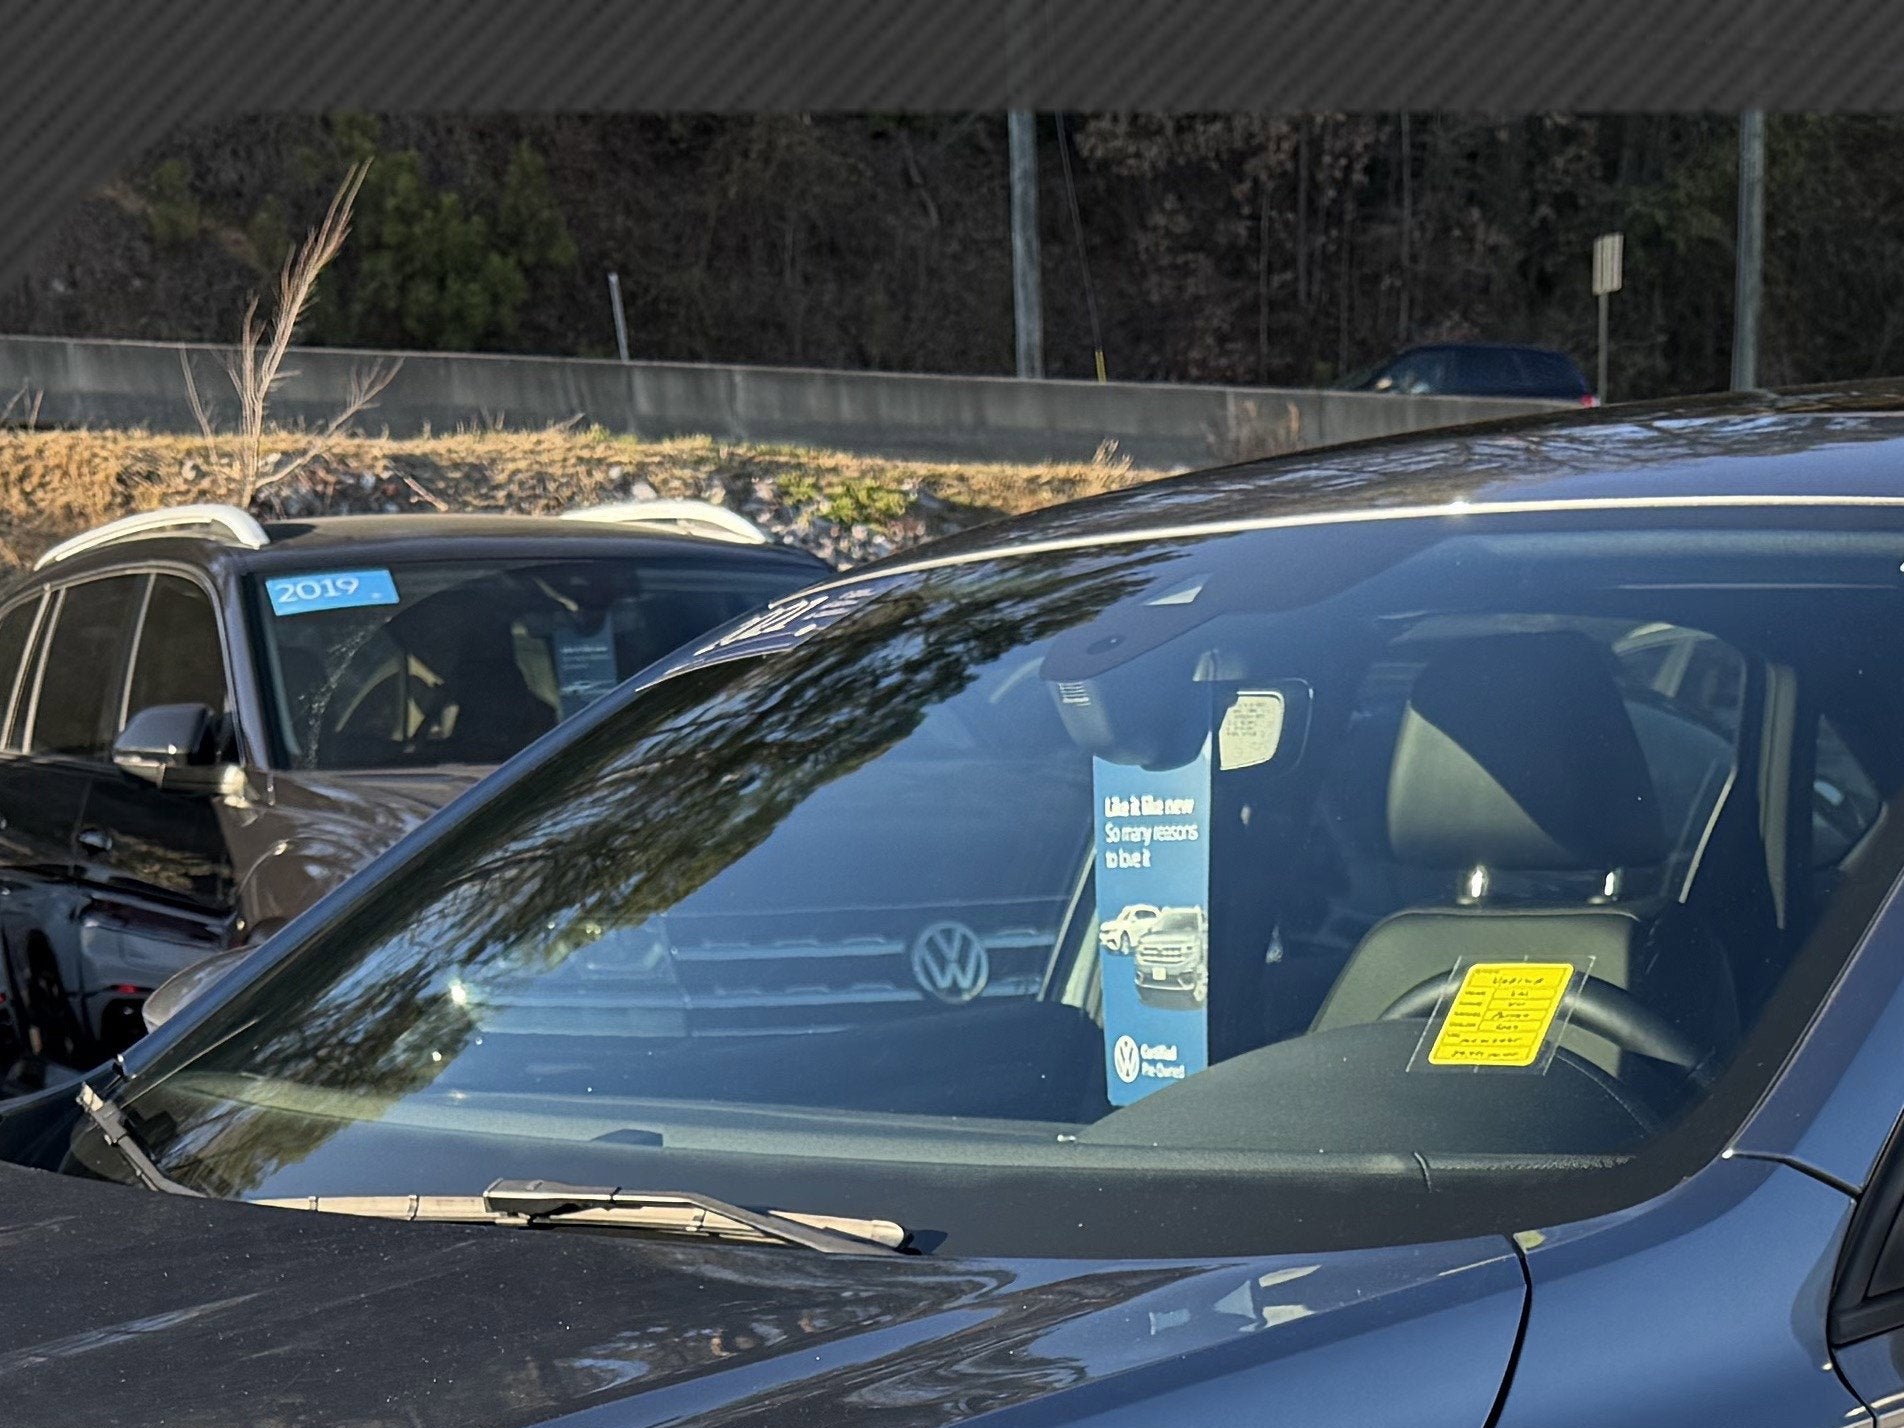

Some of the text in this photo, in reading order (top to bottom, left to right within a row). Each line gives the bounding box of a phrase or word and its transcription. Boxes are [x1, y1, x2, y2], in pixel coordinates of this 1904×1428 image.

[276, 577, 360, 603] 2019
[1104, 821, 1121, 843] So
[1153, 824, 1199, 842] reasons
